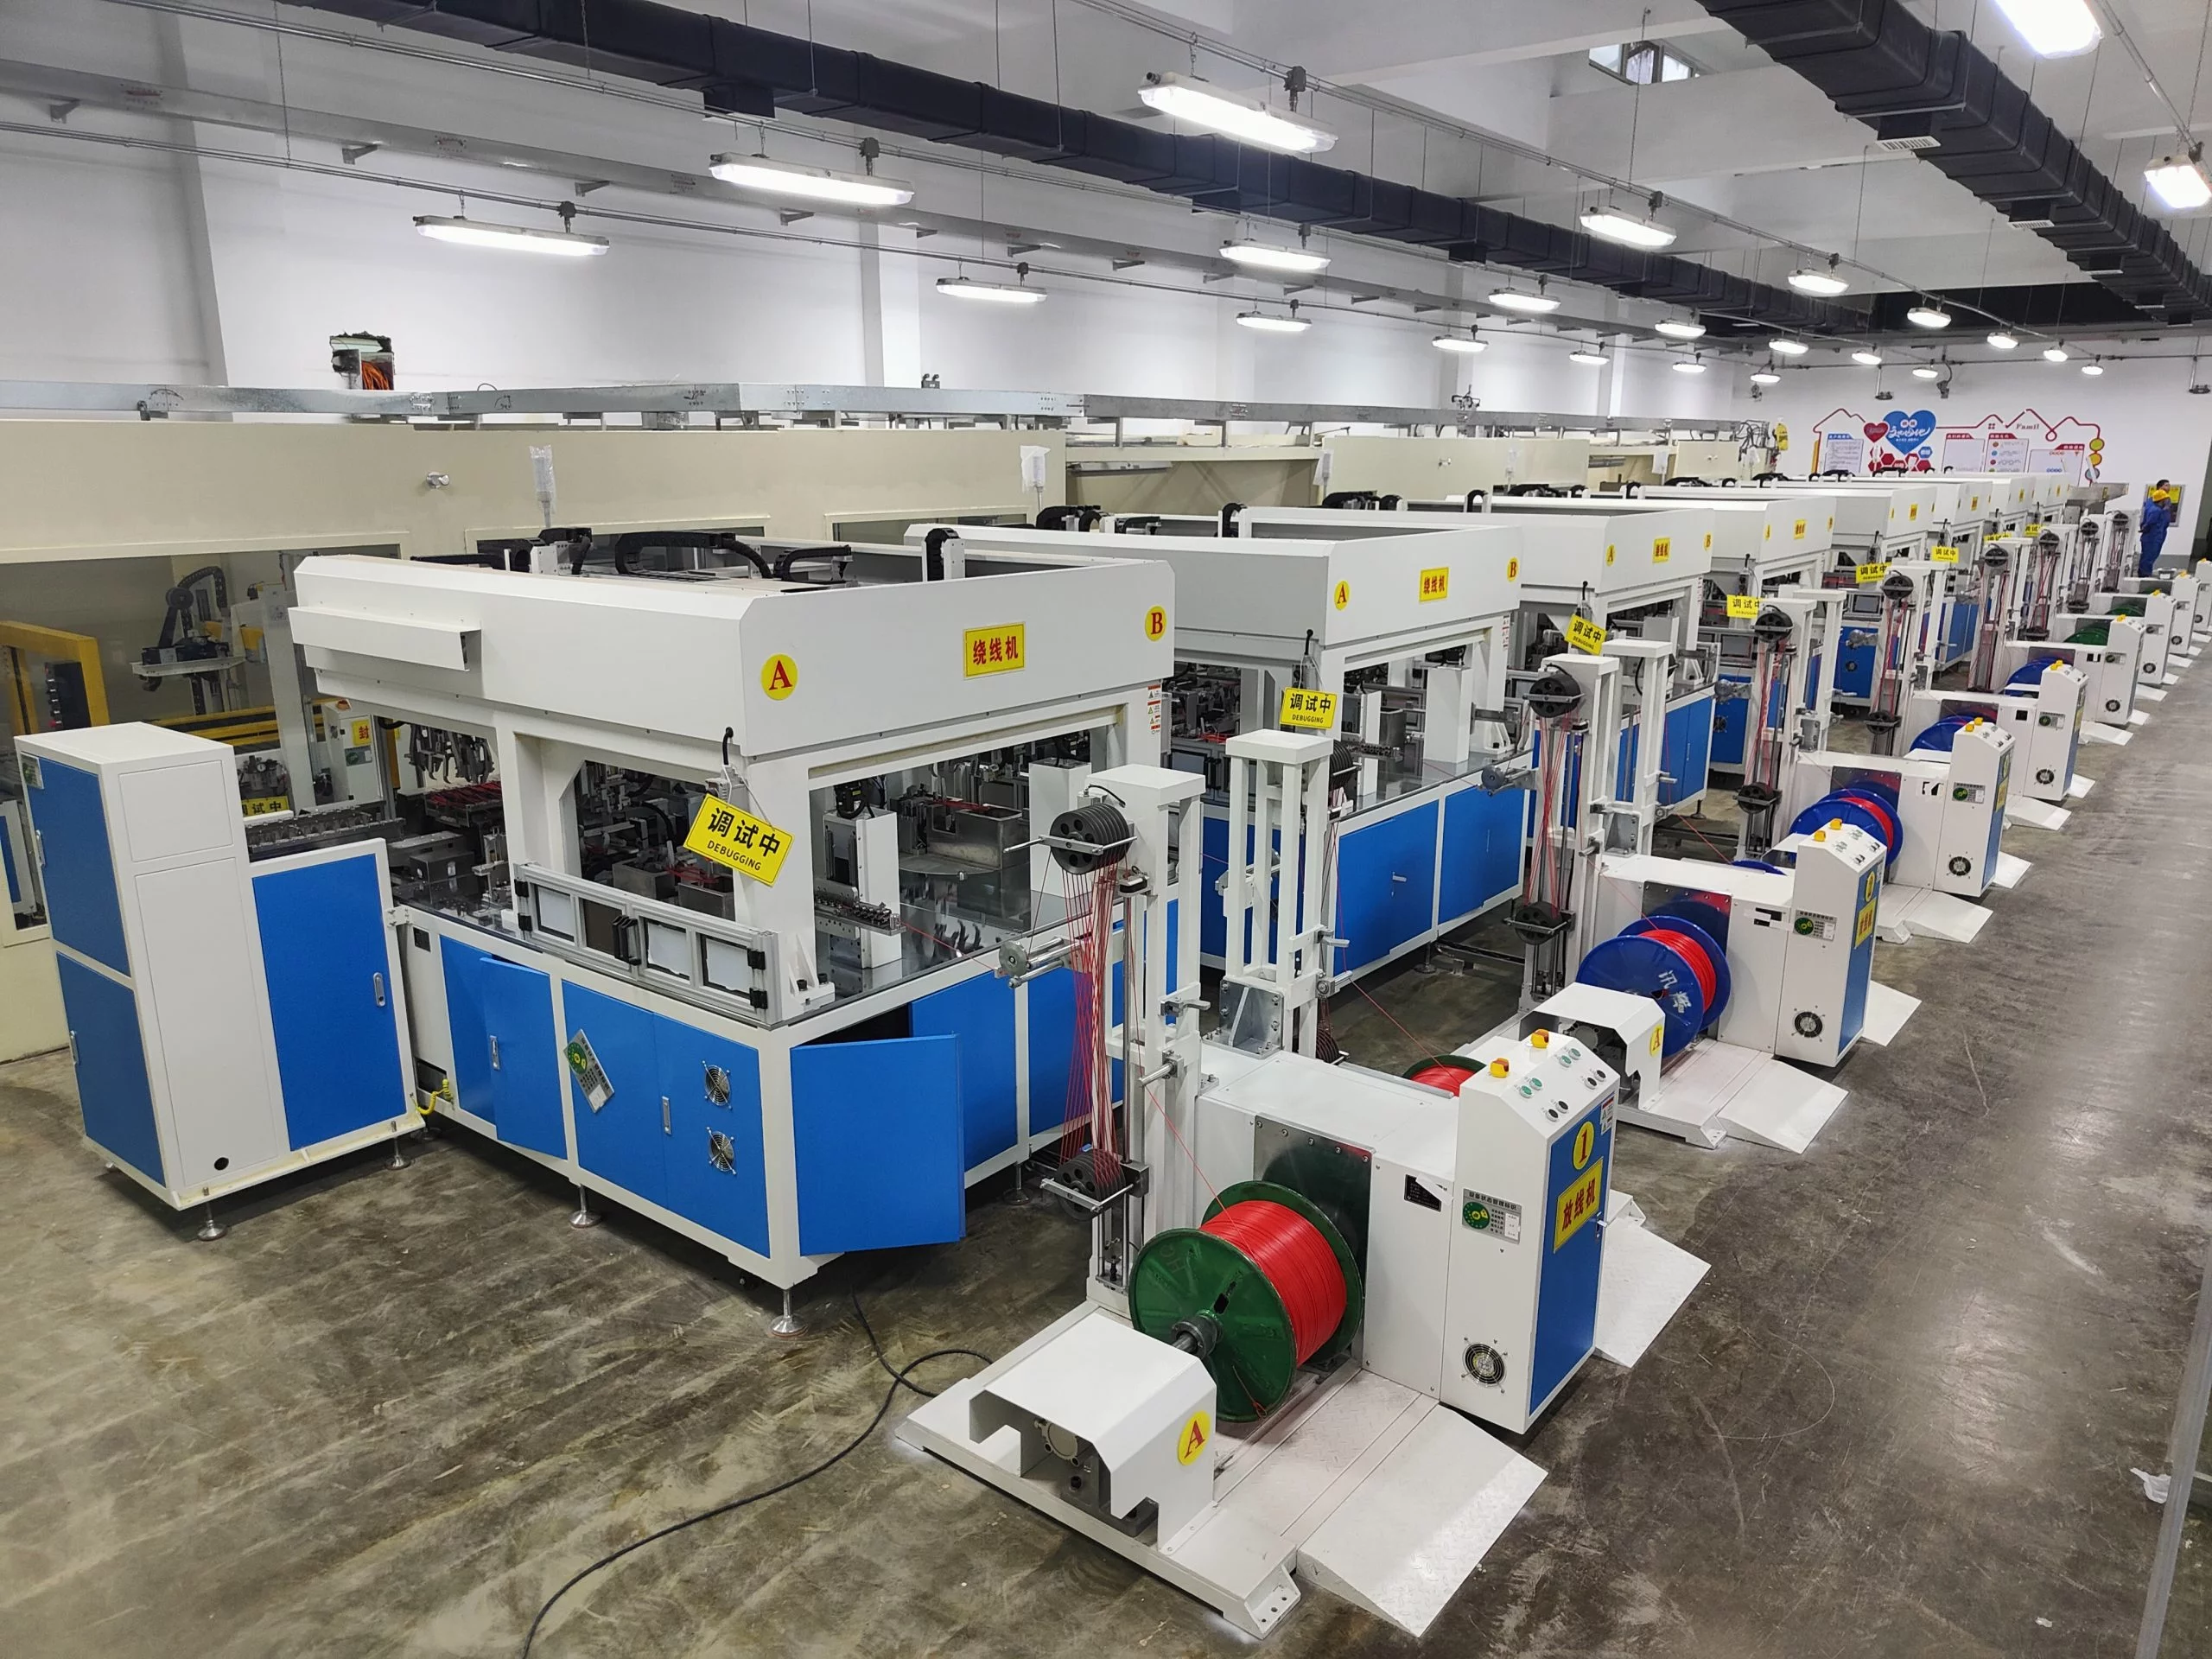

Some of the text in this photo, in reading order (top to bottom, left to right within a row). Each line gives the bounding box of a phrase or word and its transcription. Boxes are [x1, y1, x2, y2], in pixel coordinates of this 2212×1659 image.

[1607, 547, 1614, 563] A
[1509, 562, 1516, 578] B
[1337, 584, 1347, 604] A
[1423, 574, 1445, 595] 绕线机
[1150, 612, 1164, 635] B
[1573, 620, 1602, 643] 调试中
[973, 635, 1019, 665] 绕线机
[768, 660, 793, 690] A
[1289, 692, 1332, 715] 调试中
[1292, 714, 1324, 724] DEBUGGING
[708, 807, 780, 857] 调试中
[707, 840, 762, 871] DEBUGGING
[1652, 1028, 1661, 1052] A
[1579, 1128, 1588, 1164] 1
[1562, 1178, 1596, 1232] 放线机
[1184, 1420, 1205, 1459] A
